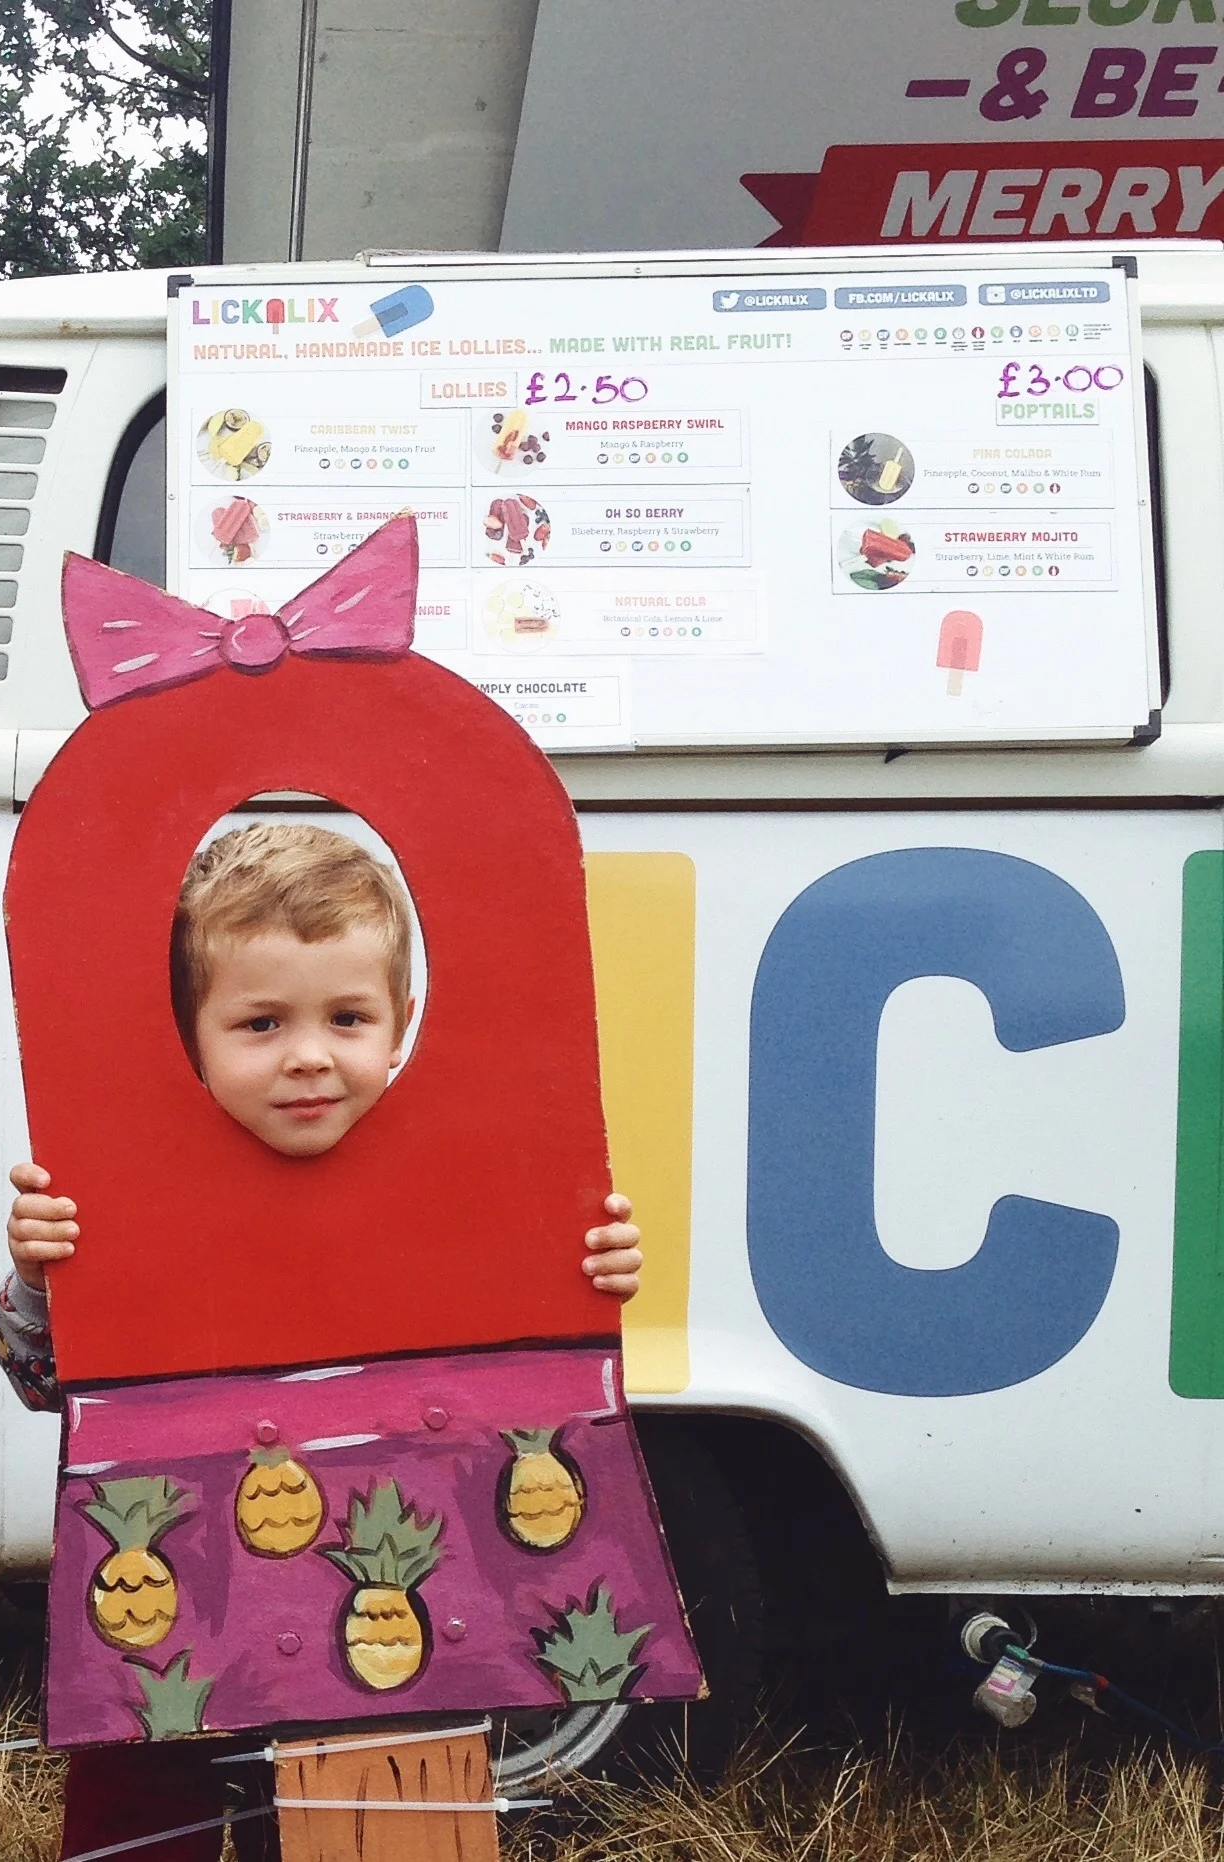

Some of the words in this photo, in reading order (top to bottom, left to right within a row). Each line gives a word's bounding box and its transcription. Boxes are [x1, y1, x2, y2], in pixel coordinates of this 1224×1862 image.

[979, 47, 1049, 121] &
[1070, 46, 1218, 118] BE
[879, 166, 1224, 238] MERRY
[848, 290, 955, 304] FB.COM/LICKALIX
[1010, 287, 1098, 300] @LICKALIXLTD
[744, 295, 809, 307] @LICKALIX
[192, 298, 339, 331] LICKALIX
[193, 343, 289, 360] NATURAL,
[295, 341, 404, 358] HANDMADE
[411, 340, 441, 356] ICE
[549, 337, 605, 353] MADE
[612, 336, 663, 352] WITH
[670, 334, 720, 351] REAL
[727, 333, 792, 350] FRUIT!
[431, 381, 508, 399] LOLLIES
[1001, 402, 1095, 420] POPTAILS
[310, 424, 376, 435] CARIBBEAN
[381, 424, 418, 435] TWIST
[565, 420, 608, 431] MANGO
[612, 419, 682, 430] RASPBERRY
[687, 418, 724, 429] SWIRL
[294, 445, 338, 454] Pineapple,
[340, 445, 370, 454] Mango
[379, 445, 413, 453] Passion
[415, 445, 436, 453] Fruit
[600, 441, 629, 450] Mango
[640, 440, 684, 450] Raspberry
[1005, 448, 1052, 459] COLADA
[923, 469, 969, 478] Pineapple,
[1011, 468, 1042, 477] Malibu
[1051, 469, 1079, 477] White
[1080, 469, 1101, 477] Rum
[277, 512, 342, 521] STRAWBERRY
[346, 512, 353, 521] &
[605, 508, 621, 519] OH
[625, 508, 641, 518] SO
[645, 508, 684, 518] BERRY
[313, 532, 364, 541] Strawberry
[571, 527, 616, 536] Blueberry,
[617, 527, 661, 536] Raspberry
[671, 527, 720, 536] Strawberry
[944, 532, 1026, 543] STRAWBERRY
[1031, 532, 1079, 542] MOJITO
[1013, 552, 1035, 561] Mint
[1044, 553, 1072, 561] White
[1073, 553, 1095, 561] Rum
[615, 596, 672, 607] NATURAL
[676, 596, 707, 607] COLA
[415, 605, 451, 616] NADE
[476, 683, 511, 694] MPLY
[516, 682, 587, 694] CHOCOLATE
